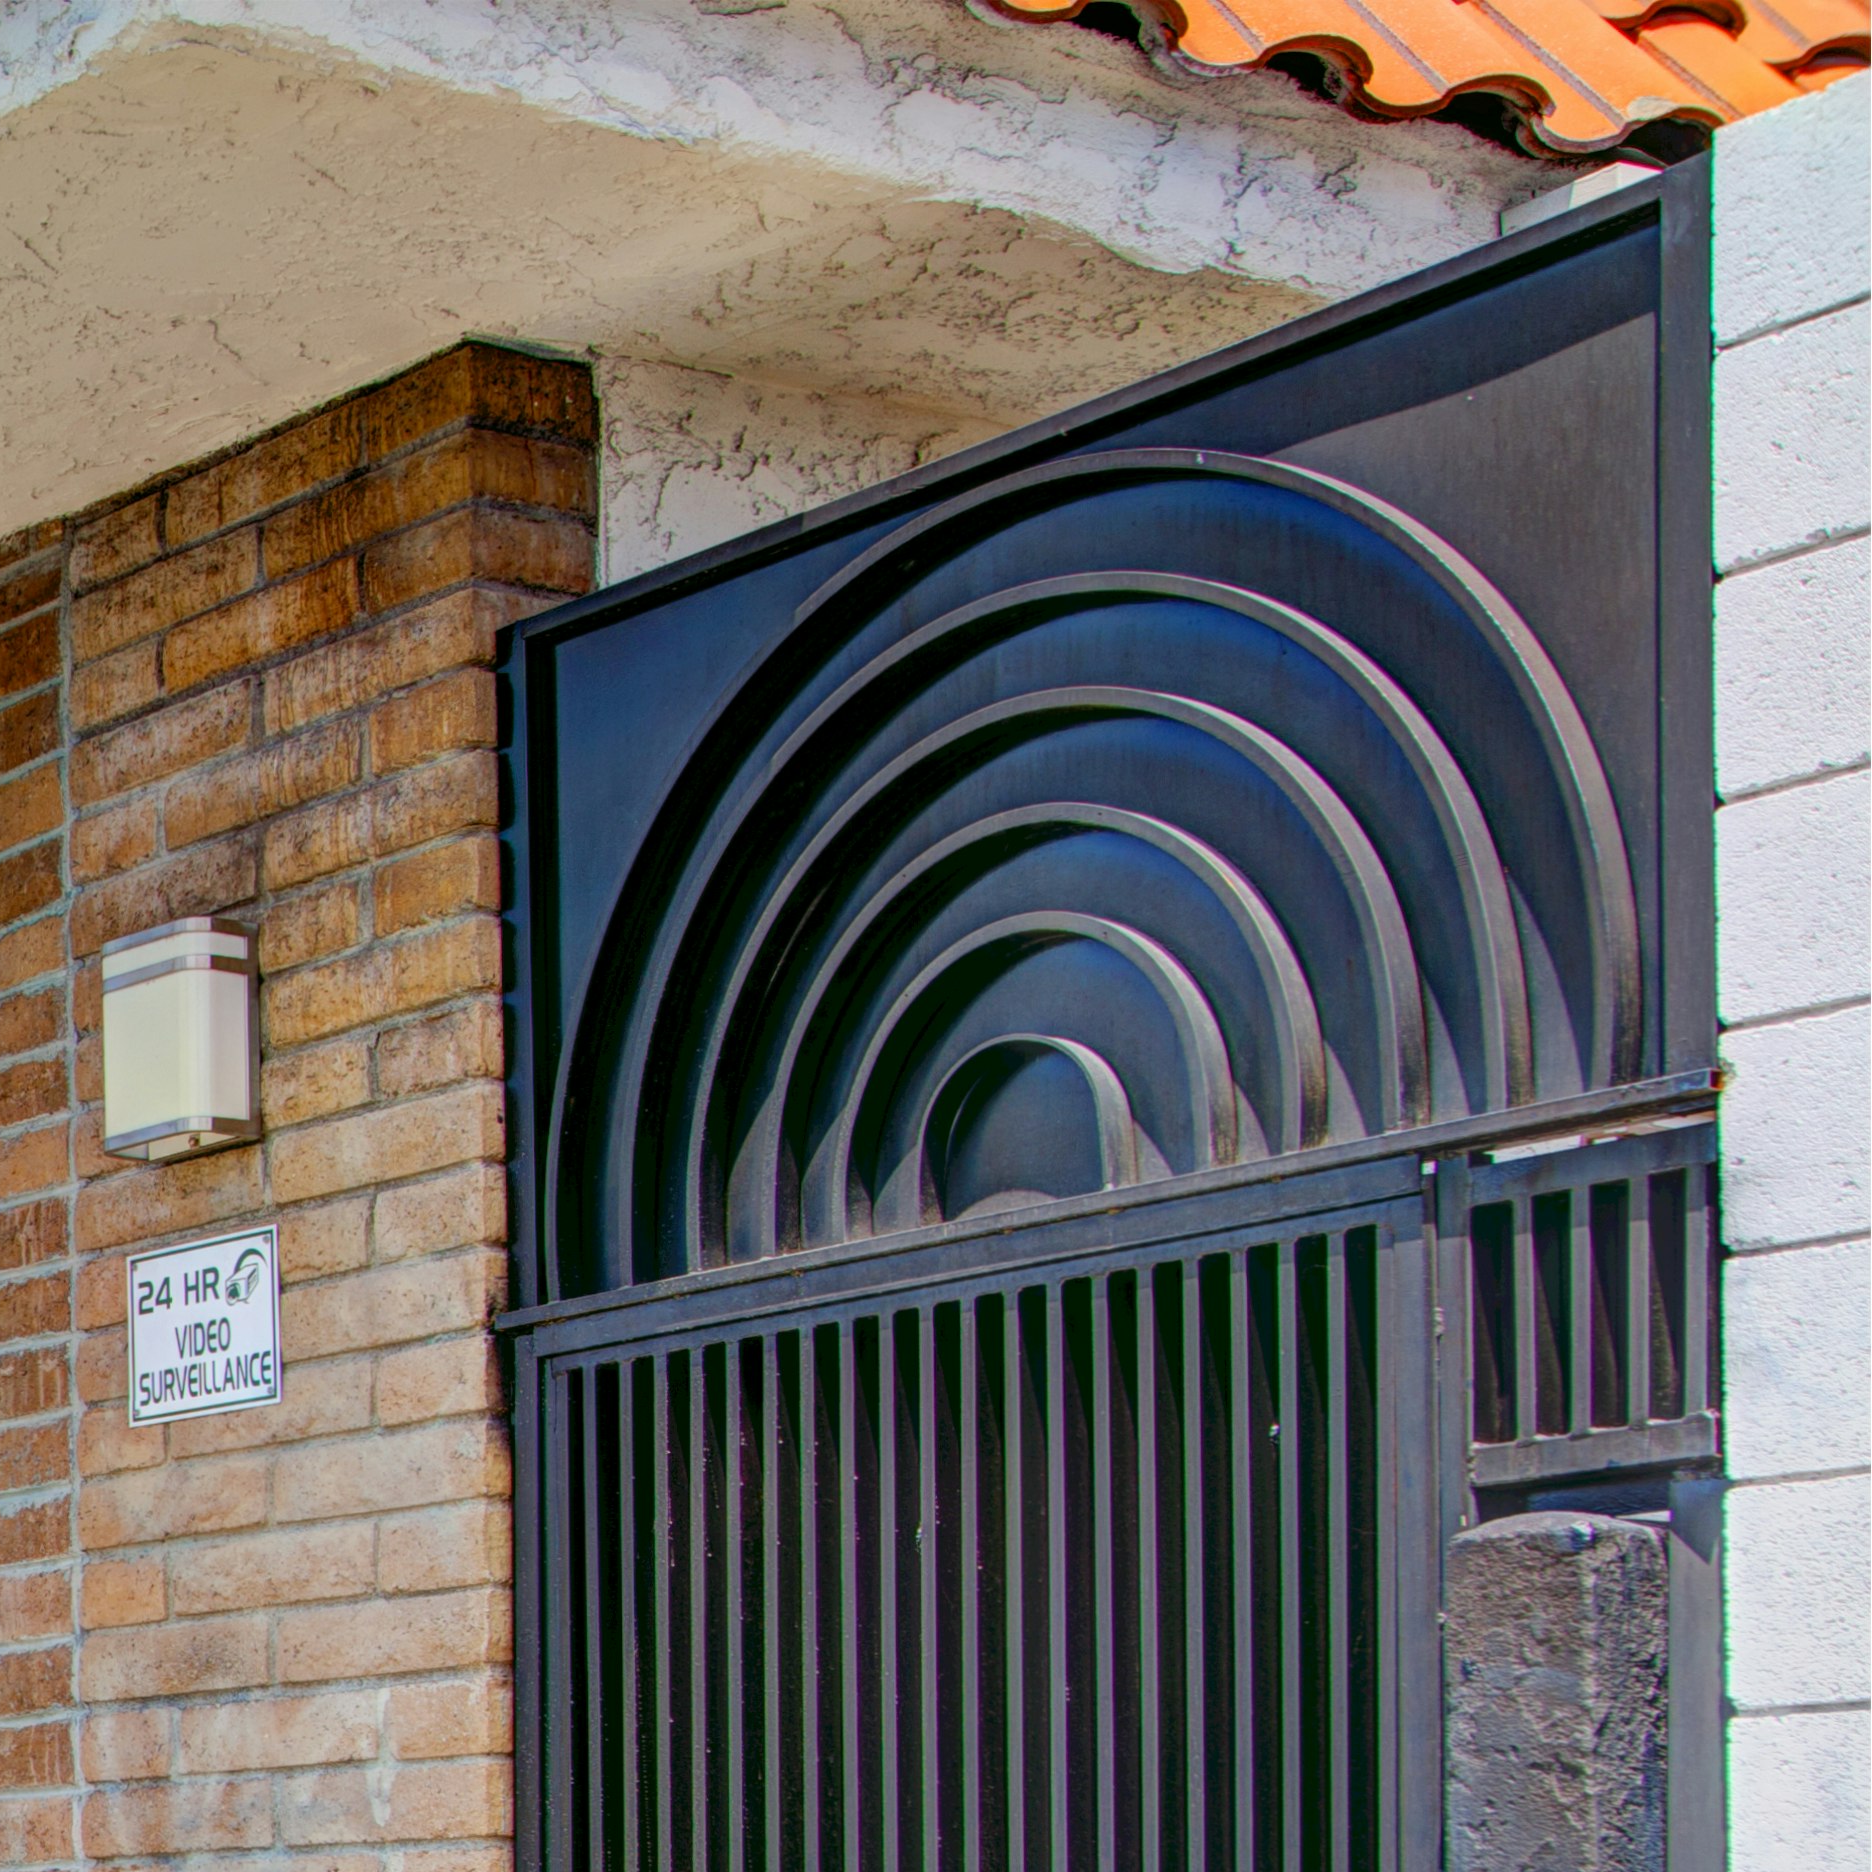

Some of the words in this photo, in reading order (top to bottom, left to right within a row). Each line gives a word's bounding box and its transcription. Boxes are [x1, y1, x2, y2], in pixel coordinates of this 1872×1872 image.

[137, 1276, 173, 1316] 24
[183, 1266, 221, 1306] HR
[174, 1317, 231, 1360] VIDEO
[139, 1350, 272, 1407] SURVEILLANCE
